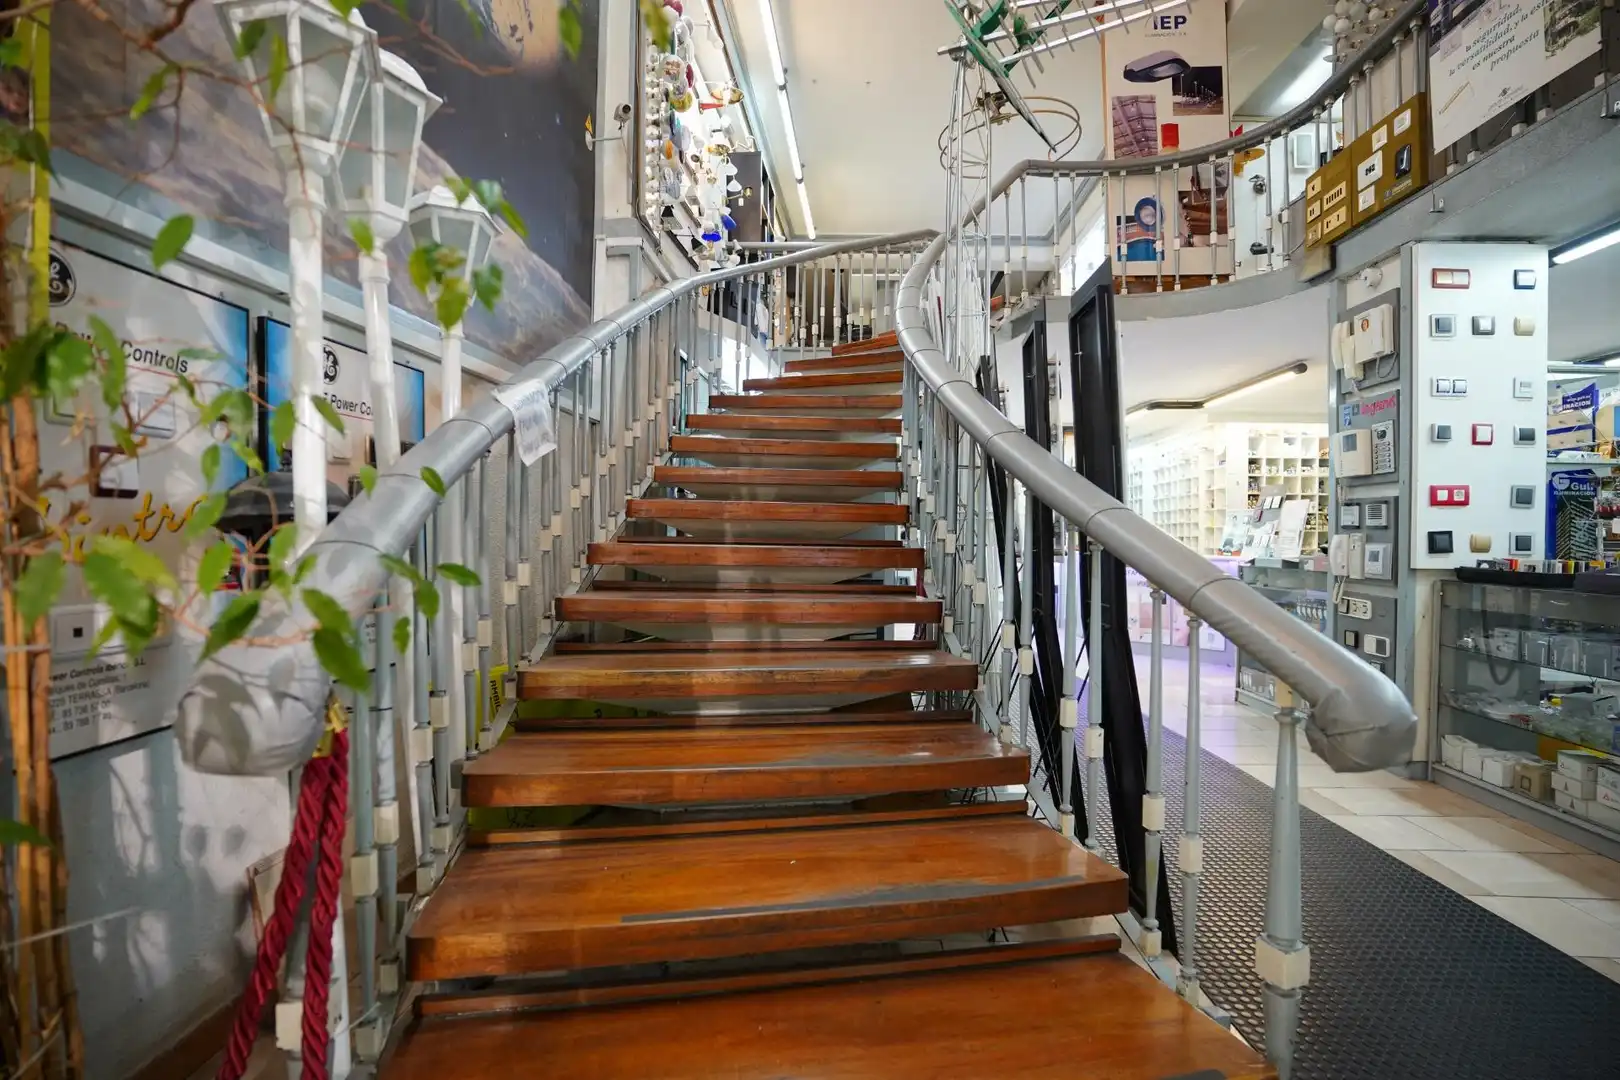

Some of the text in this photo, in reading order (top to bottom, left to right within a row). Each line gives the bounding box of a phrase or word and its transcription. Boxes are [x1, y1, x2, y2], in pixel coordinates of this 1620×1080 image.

[1472, 4, 1522, 47] seguridad,
[1482, 35, 1515, 62] nuestra
[1490, 30, 1539, 71] propuesta
[120, 340, 189, 374] Controls
[330, 394, 358, 412] Power
